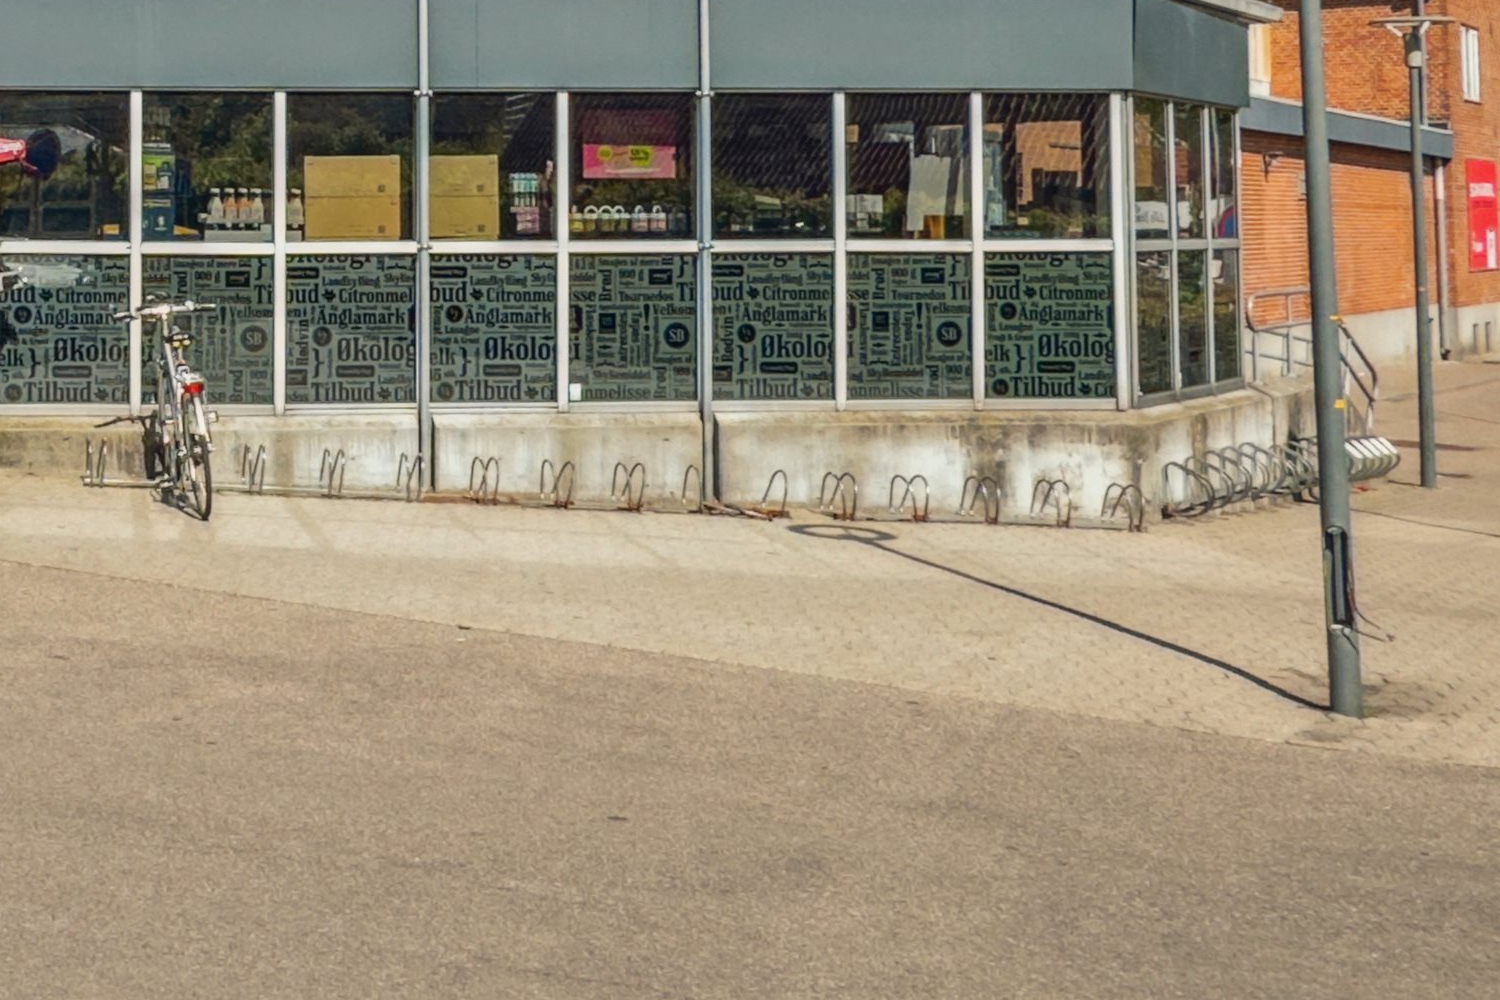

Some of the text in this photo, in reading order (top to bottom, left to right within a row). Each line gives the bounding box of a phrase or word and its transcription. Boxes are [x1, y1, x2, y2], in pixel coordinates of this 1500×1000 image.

[317, 305, 405, 328] Änglamark
[465, 304, 552, 327] Änglamark
[742, 302, 827, 326] Änglamark
[1019, 302, 1104, 325] Änglamark
[940, 327, 956, 340] SB
[23, 381, 91, 401] Tilbud
[311, 381, 374, 401] Tilbud
[455, 379, 522, 400] Tilbud
[736, 378, 798, 398] Tilbud
[1010, 376, 1075, 397] Tilbud
